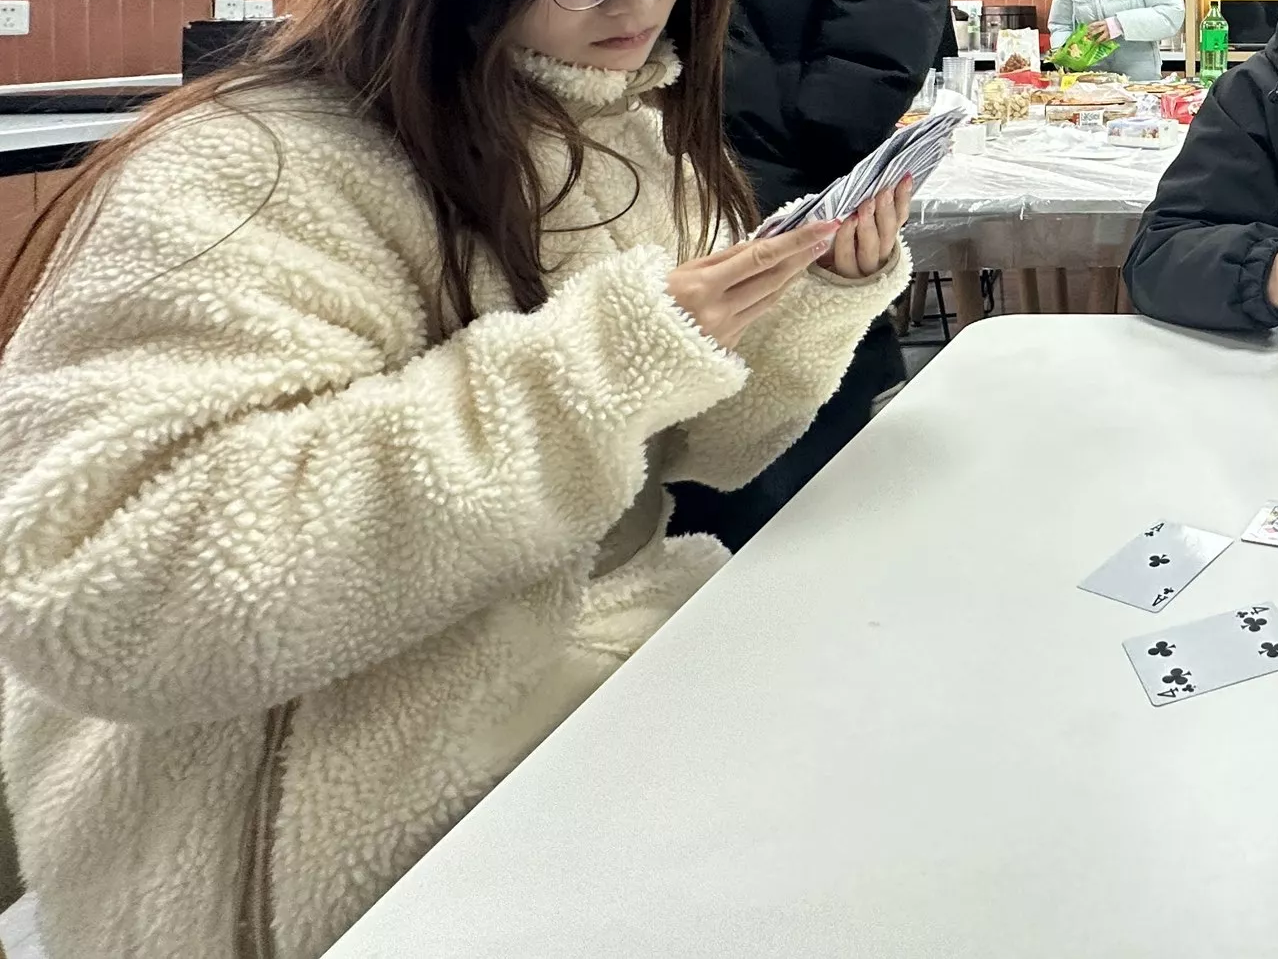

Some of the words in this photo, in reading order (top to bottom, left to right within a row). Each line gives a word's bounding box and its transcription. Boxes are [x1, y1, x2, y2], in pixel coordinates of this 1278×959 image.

[1150, 523, 1164, 532] A
[1152, 594, 1168, 606] A
[1250, 606, 1270, 615] 4
[1157, 687, 1179, 698] 4
